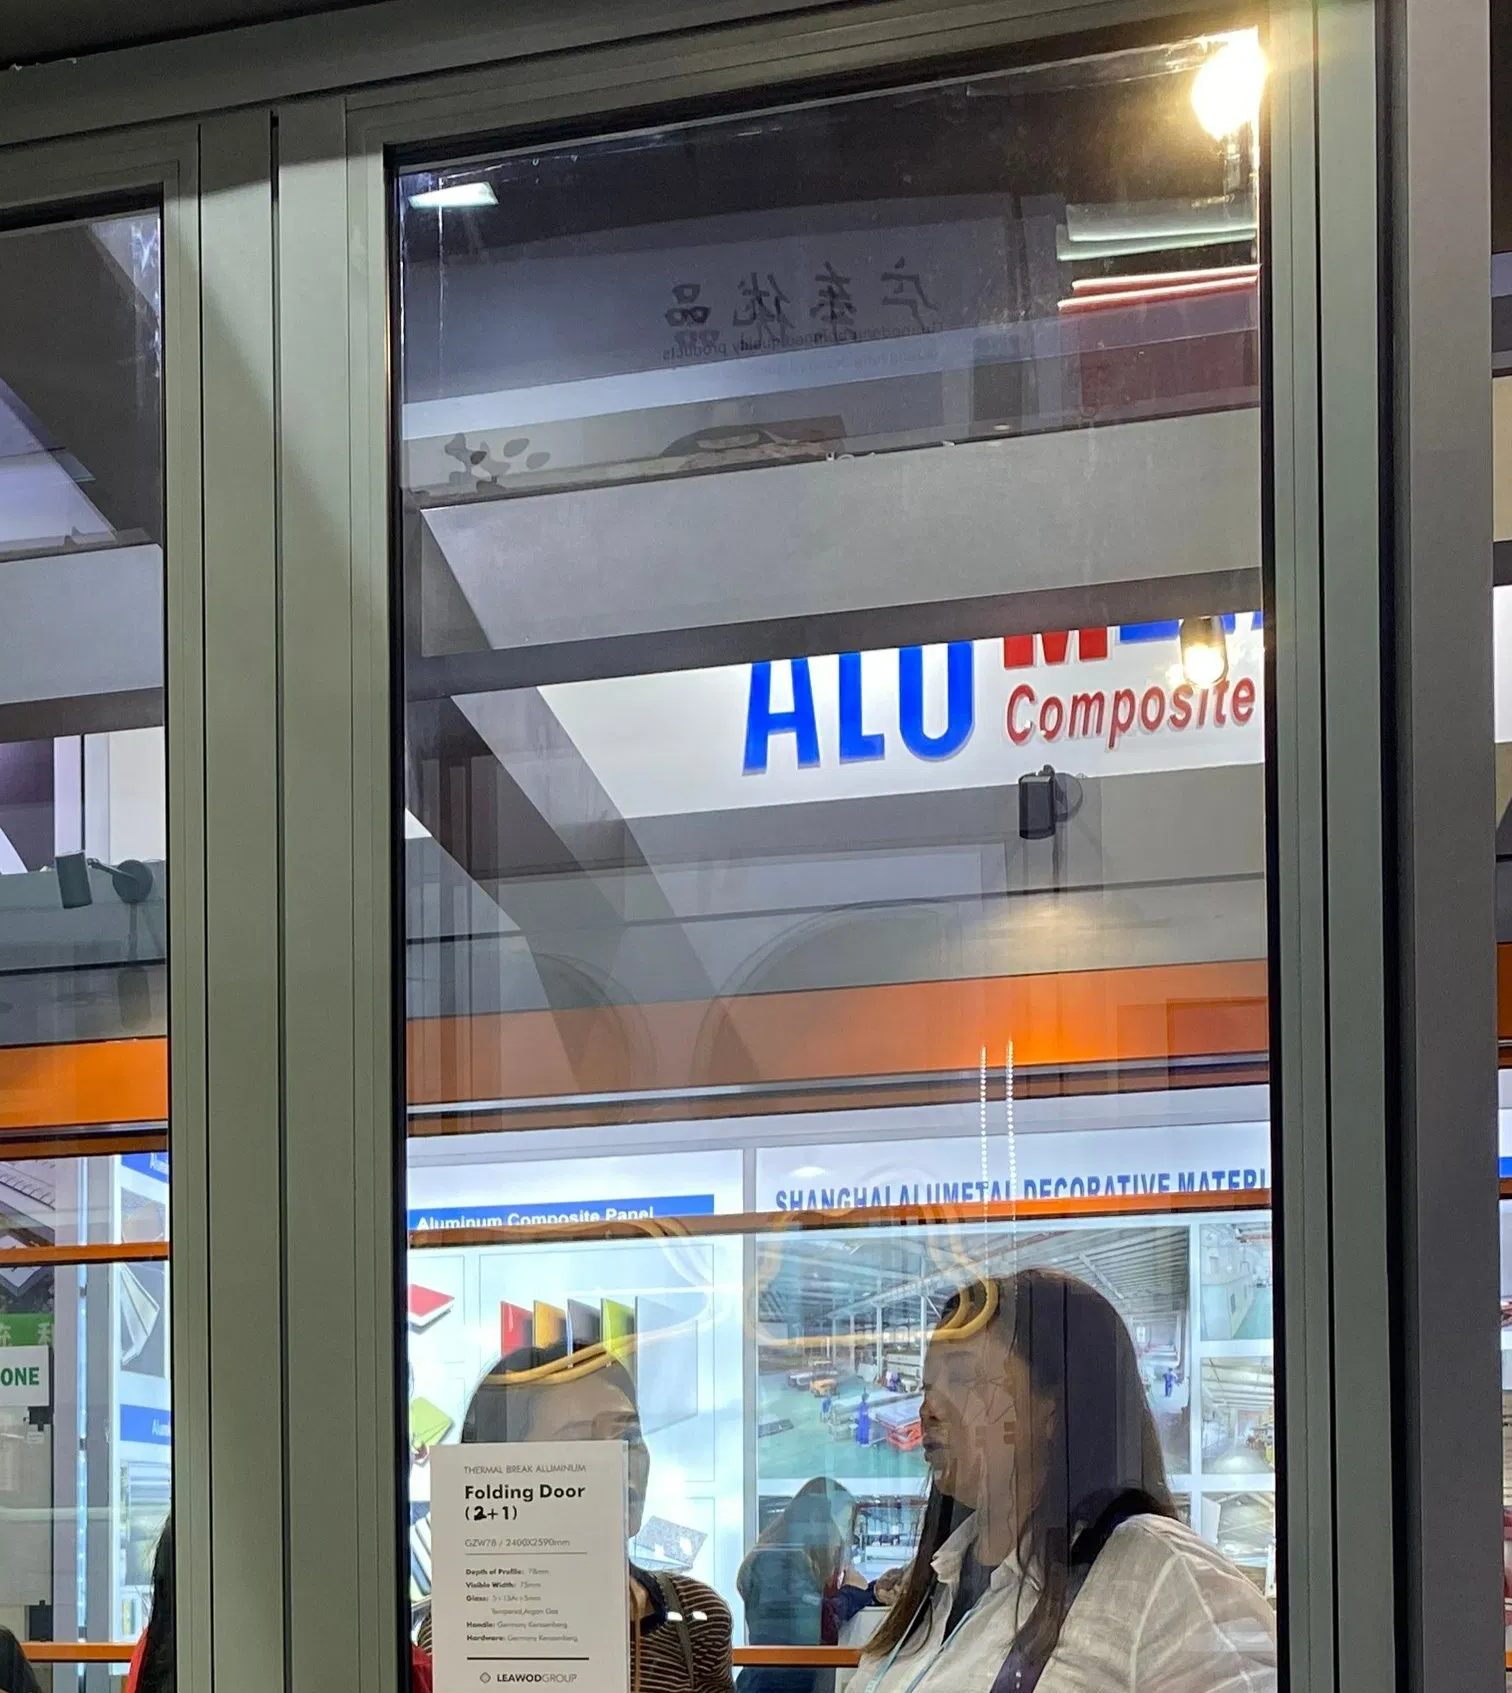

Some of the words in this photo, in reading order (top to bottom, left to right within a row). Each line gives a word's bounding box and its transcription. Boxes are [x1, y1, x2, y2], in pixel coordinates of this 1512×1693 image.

[1006, 676, 1256, 751] Composite
[775, 1185, 885, 1211] SHANGHAI
[1024, 1172, 1170, 1200] DECORATIVE
[416, 1215, 502, 1230] Aluminum
[507, 1209, 600, 1226] Composite
[605, 1206, 654, 1221] Panel
[464, 1465, 503, 1475] THERMAL
[506, 1464, 533, 1474] BREAK
[464, 1484, 534, 1502] Folding
[540, 1484, 586, 1498] Door
[465, 1568, 488, 1576] Depth
[465, 1581, 491, 1589] Visible
[497, 1673, 578, 1683] LEAWODGROUP
